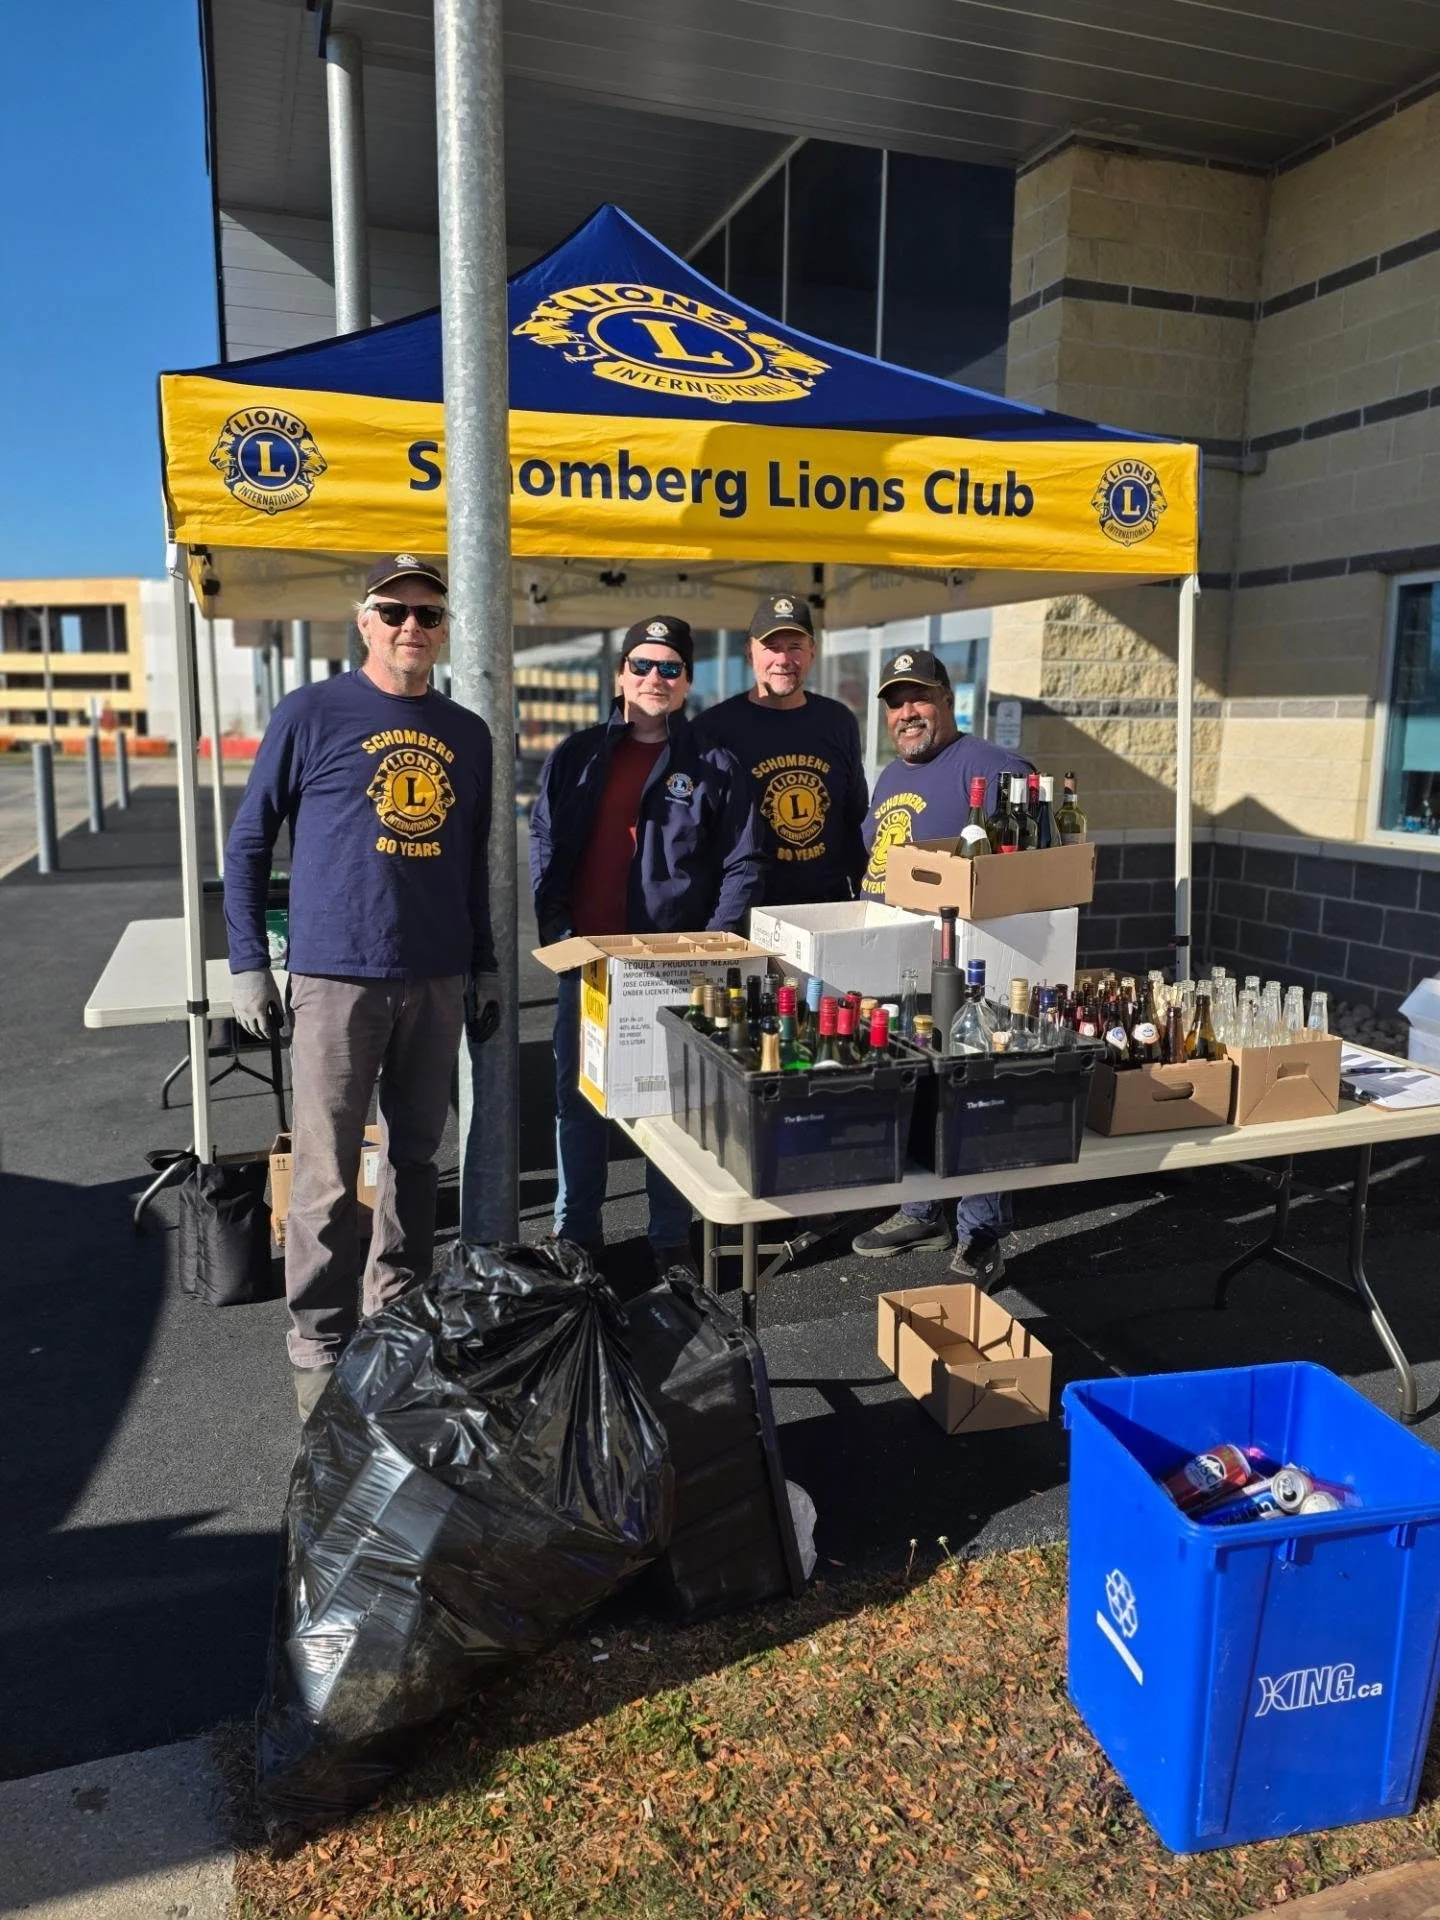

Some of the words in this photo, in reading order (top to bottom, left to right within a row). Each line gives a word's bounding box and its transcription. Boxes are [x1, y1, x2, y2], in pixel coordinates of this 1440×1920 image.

[561, 286, 739, 327] LIONS
[632, 318, 734, 367] L
[609, 366, 796, 397] INTERNATIONAL
[233, 410, 301, 436] LIONS
[256, 440, 287, 478] L
[1109, 462, 1153, 481] LIONS
[407, 440, 748, 519] Somberg
[768, 460, 905, 513] Lions
[924, 468, 1034, 518] Club
[238, 485, 303, 506] INTERNATIONAL
[1121, 486, 1141, 516] L
[1106, 524, 1150, 540] INTERNATIONAL
[361, 729, 455, 764] SCHOMBERG
[387, 752, 439, 774] LIONS
[751, 753, 831, 779] SCHOMBERG
[405, 776, 426, 807] L
[773, 773, 818, 790] LIONS
[789, 793, 809, 820] L
[874, 792, 927, 820] SCHOMBERG
[385, 813, 438, 832] INTERNATIONAL
[883, 812, 909, 829] LIONS
[375, 836, 397, 854] 80
[399, 841, 442, 857] YEARS
[795, 842, 826, 861] YEARS
[868, 881, 886, 894] YEAR
[623, 961, 656, 970] TEQUILA
[662, 960, 697, 968] PRODUCT
[1254, 1662, 1383, 1717] KING.ca
